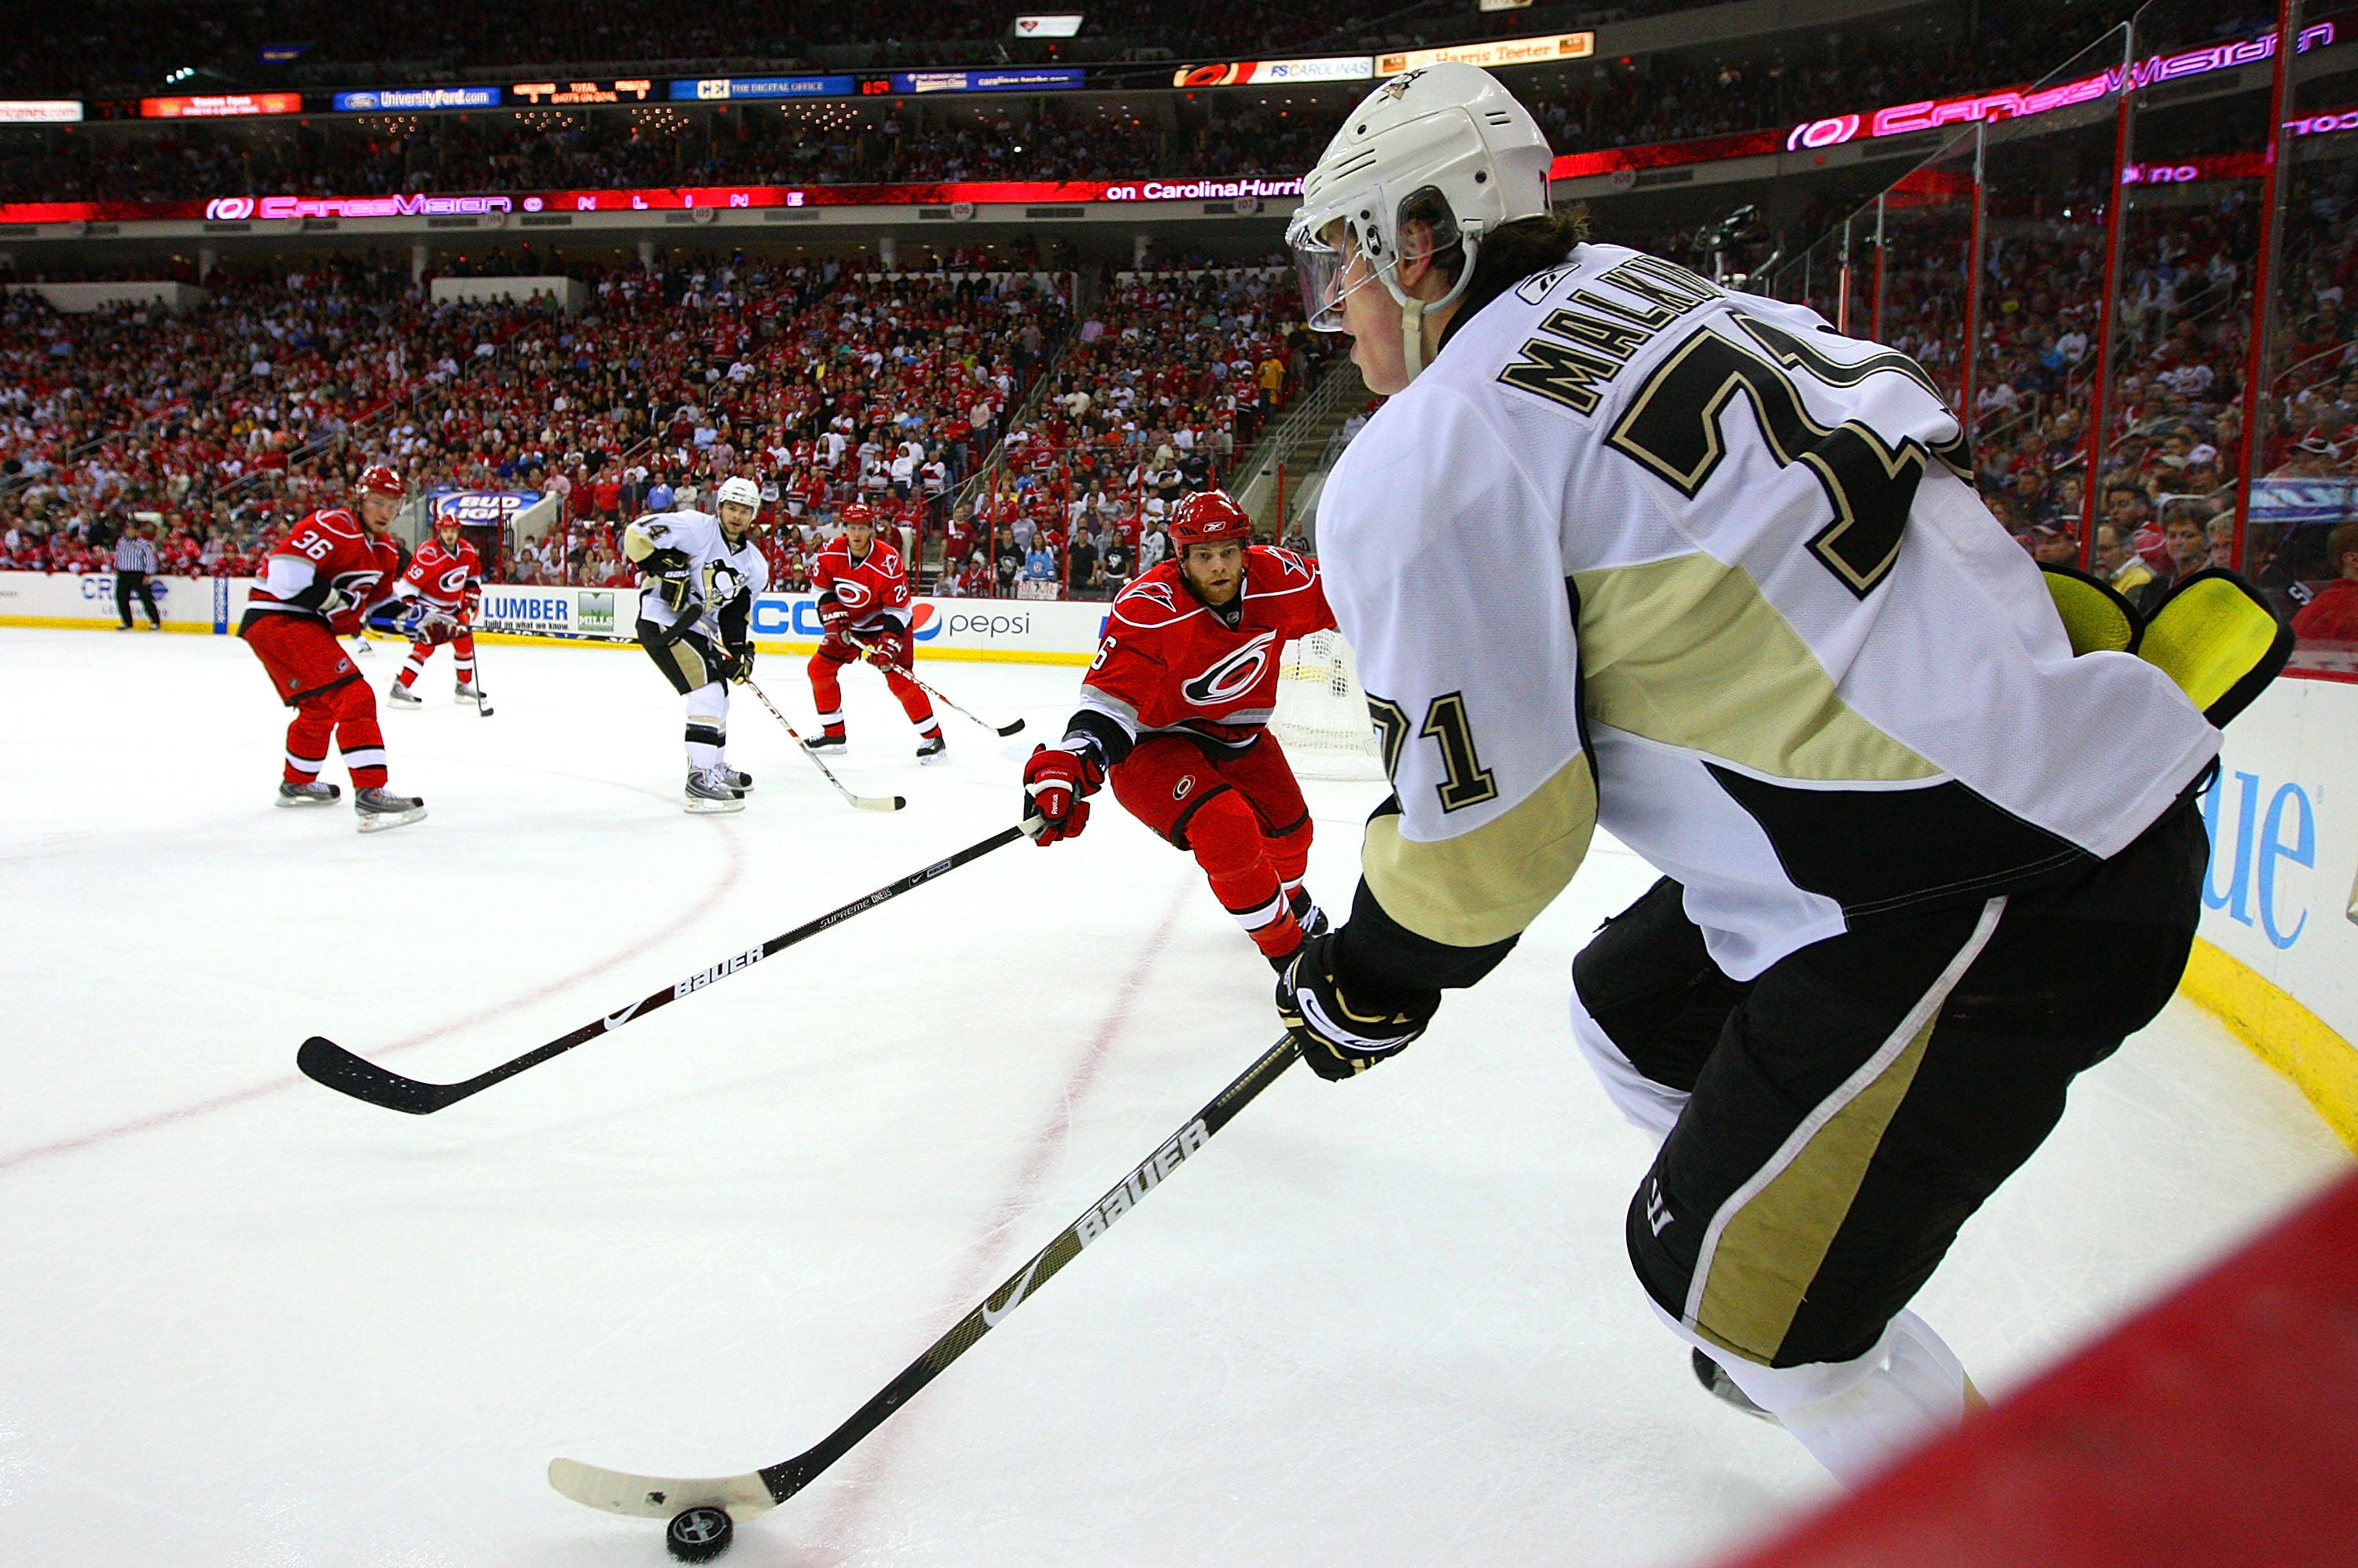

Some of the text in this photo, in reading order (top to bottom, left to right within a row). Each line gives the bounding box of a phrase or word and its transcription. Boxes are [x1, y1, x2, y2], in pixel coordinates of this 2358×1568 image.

[1496, 44, 1551, 60] Teeter
[570, 83, 597, 92] TOTAL
[593, 90, 619, 102] GOAL
[697, 79, 823, 100] CEI THE DIGITAL OFFICE
[381, 89, 490, 109] UniversityFord.com
[1107, 185, 1136, 200] on
[458, 496, 521, 509] BUD
[637, 516, 671, 542] 14
[291, 530, 335, 560] 36
[483, 597, 568, 620] LUMBER
[516, 621, 534, 630] what
[578, 615, 613, 626] MILLS
[949, 612, 1030, 637] pepsi
[1091, 635, 1117, 670] 6
